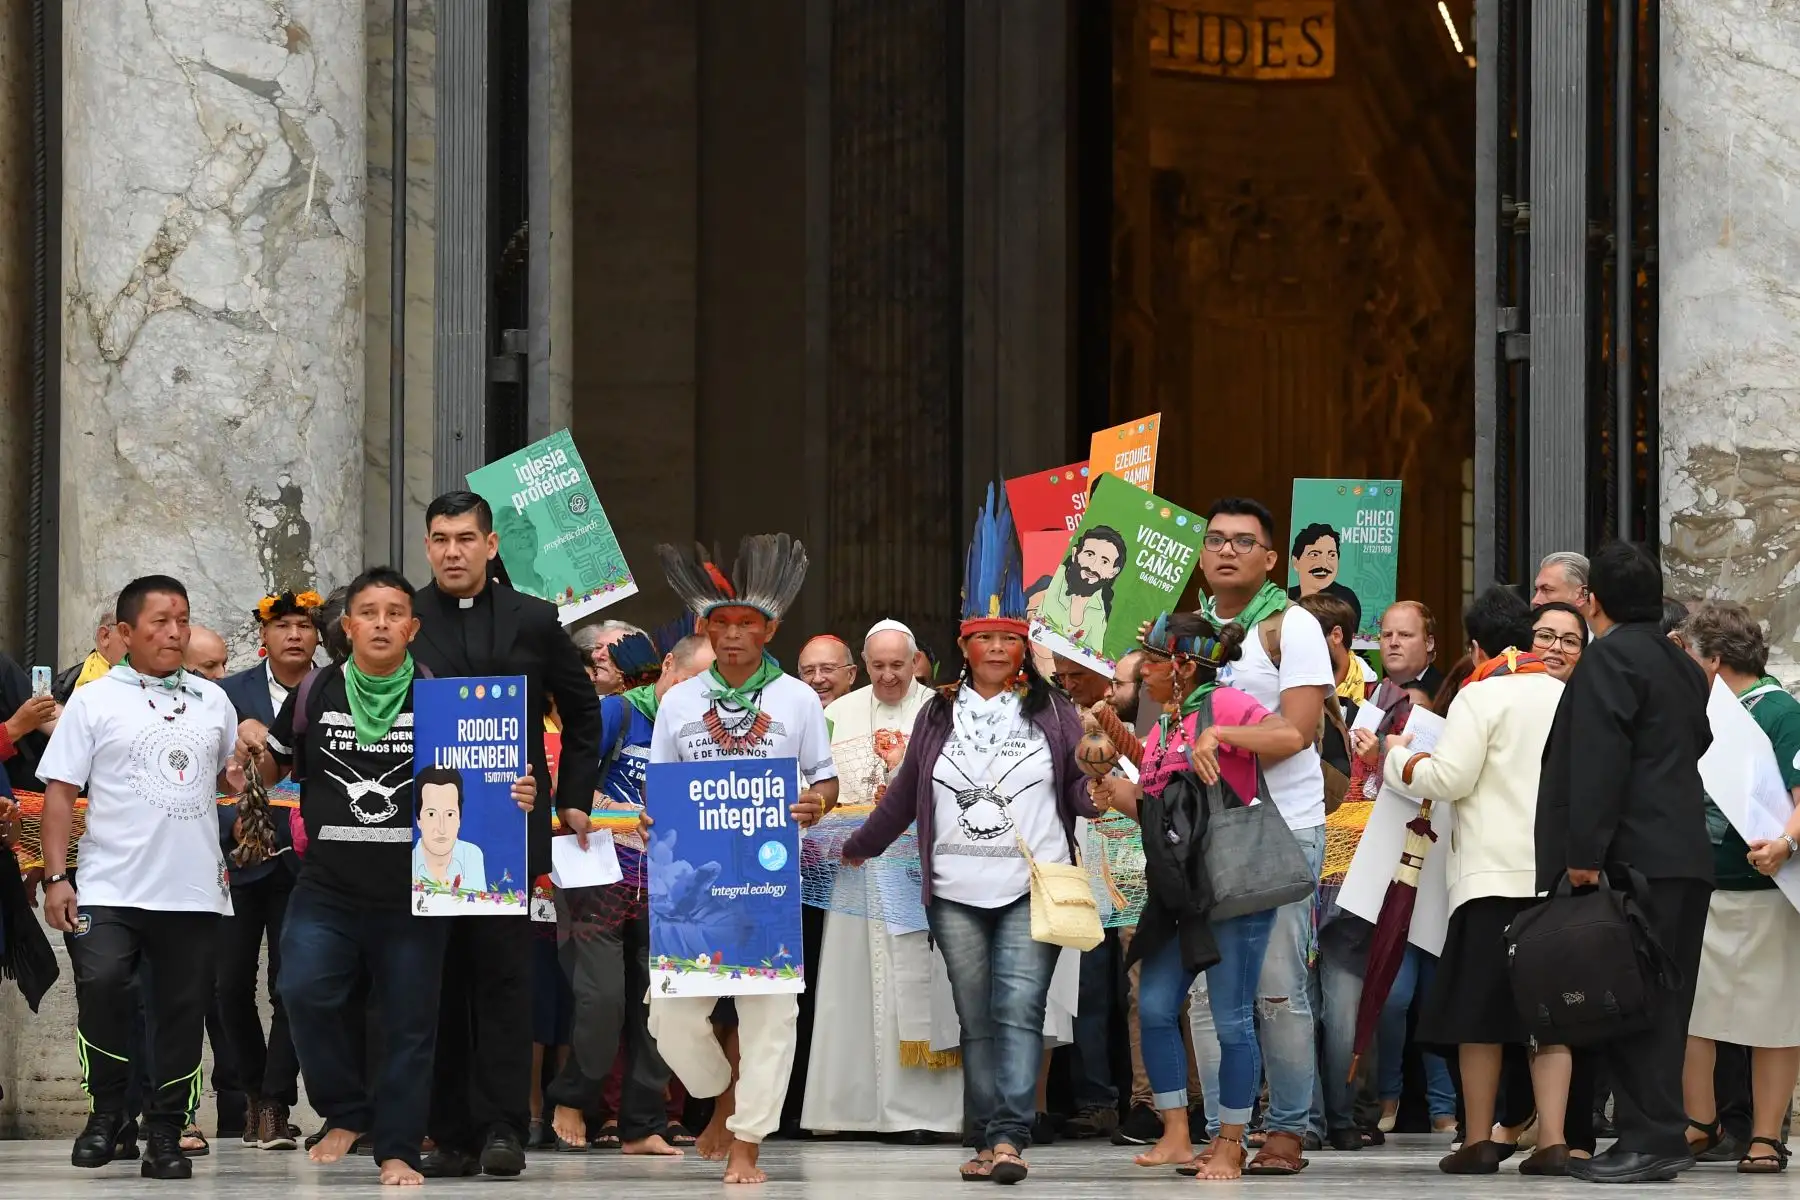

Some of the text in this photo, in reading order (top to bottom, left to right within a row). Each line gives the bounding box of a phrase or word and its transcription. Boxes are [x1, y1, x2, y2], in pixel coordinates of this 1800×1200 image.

[512, 446, 568, 487] iglesia
[1115, 445, 1151, 471] EZEQUIEL
[1123, 463, 1151, 485] RAMIN
[511, 467, 581, 516] profética
[1356, 509, 1394, 527] CHICO
[1136, 524, 1194, 566] VICENTE
[1341, 527, 1393, 544] MENDES
[1135, 549, 1184, 584] CAÑAS
[326, 727, 333, 737] A
[458, 718, 518, 742] RODOLFO
[330, 738, 337, 750] É
[339, 741, 353, 751] DE
[392, 742, 413, 753] NÓS
[435, 745, 519, 769] LUNKENBEIN
[701, 750, 713, 759] DE
[627, 758, 634, 766] A
[689, 769, 785, 807] ecología
[699, 803, 787, 837] integral
[711, 881, 787, 899] integral ecology
